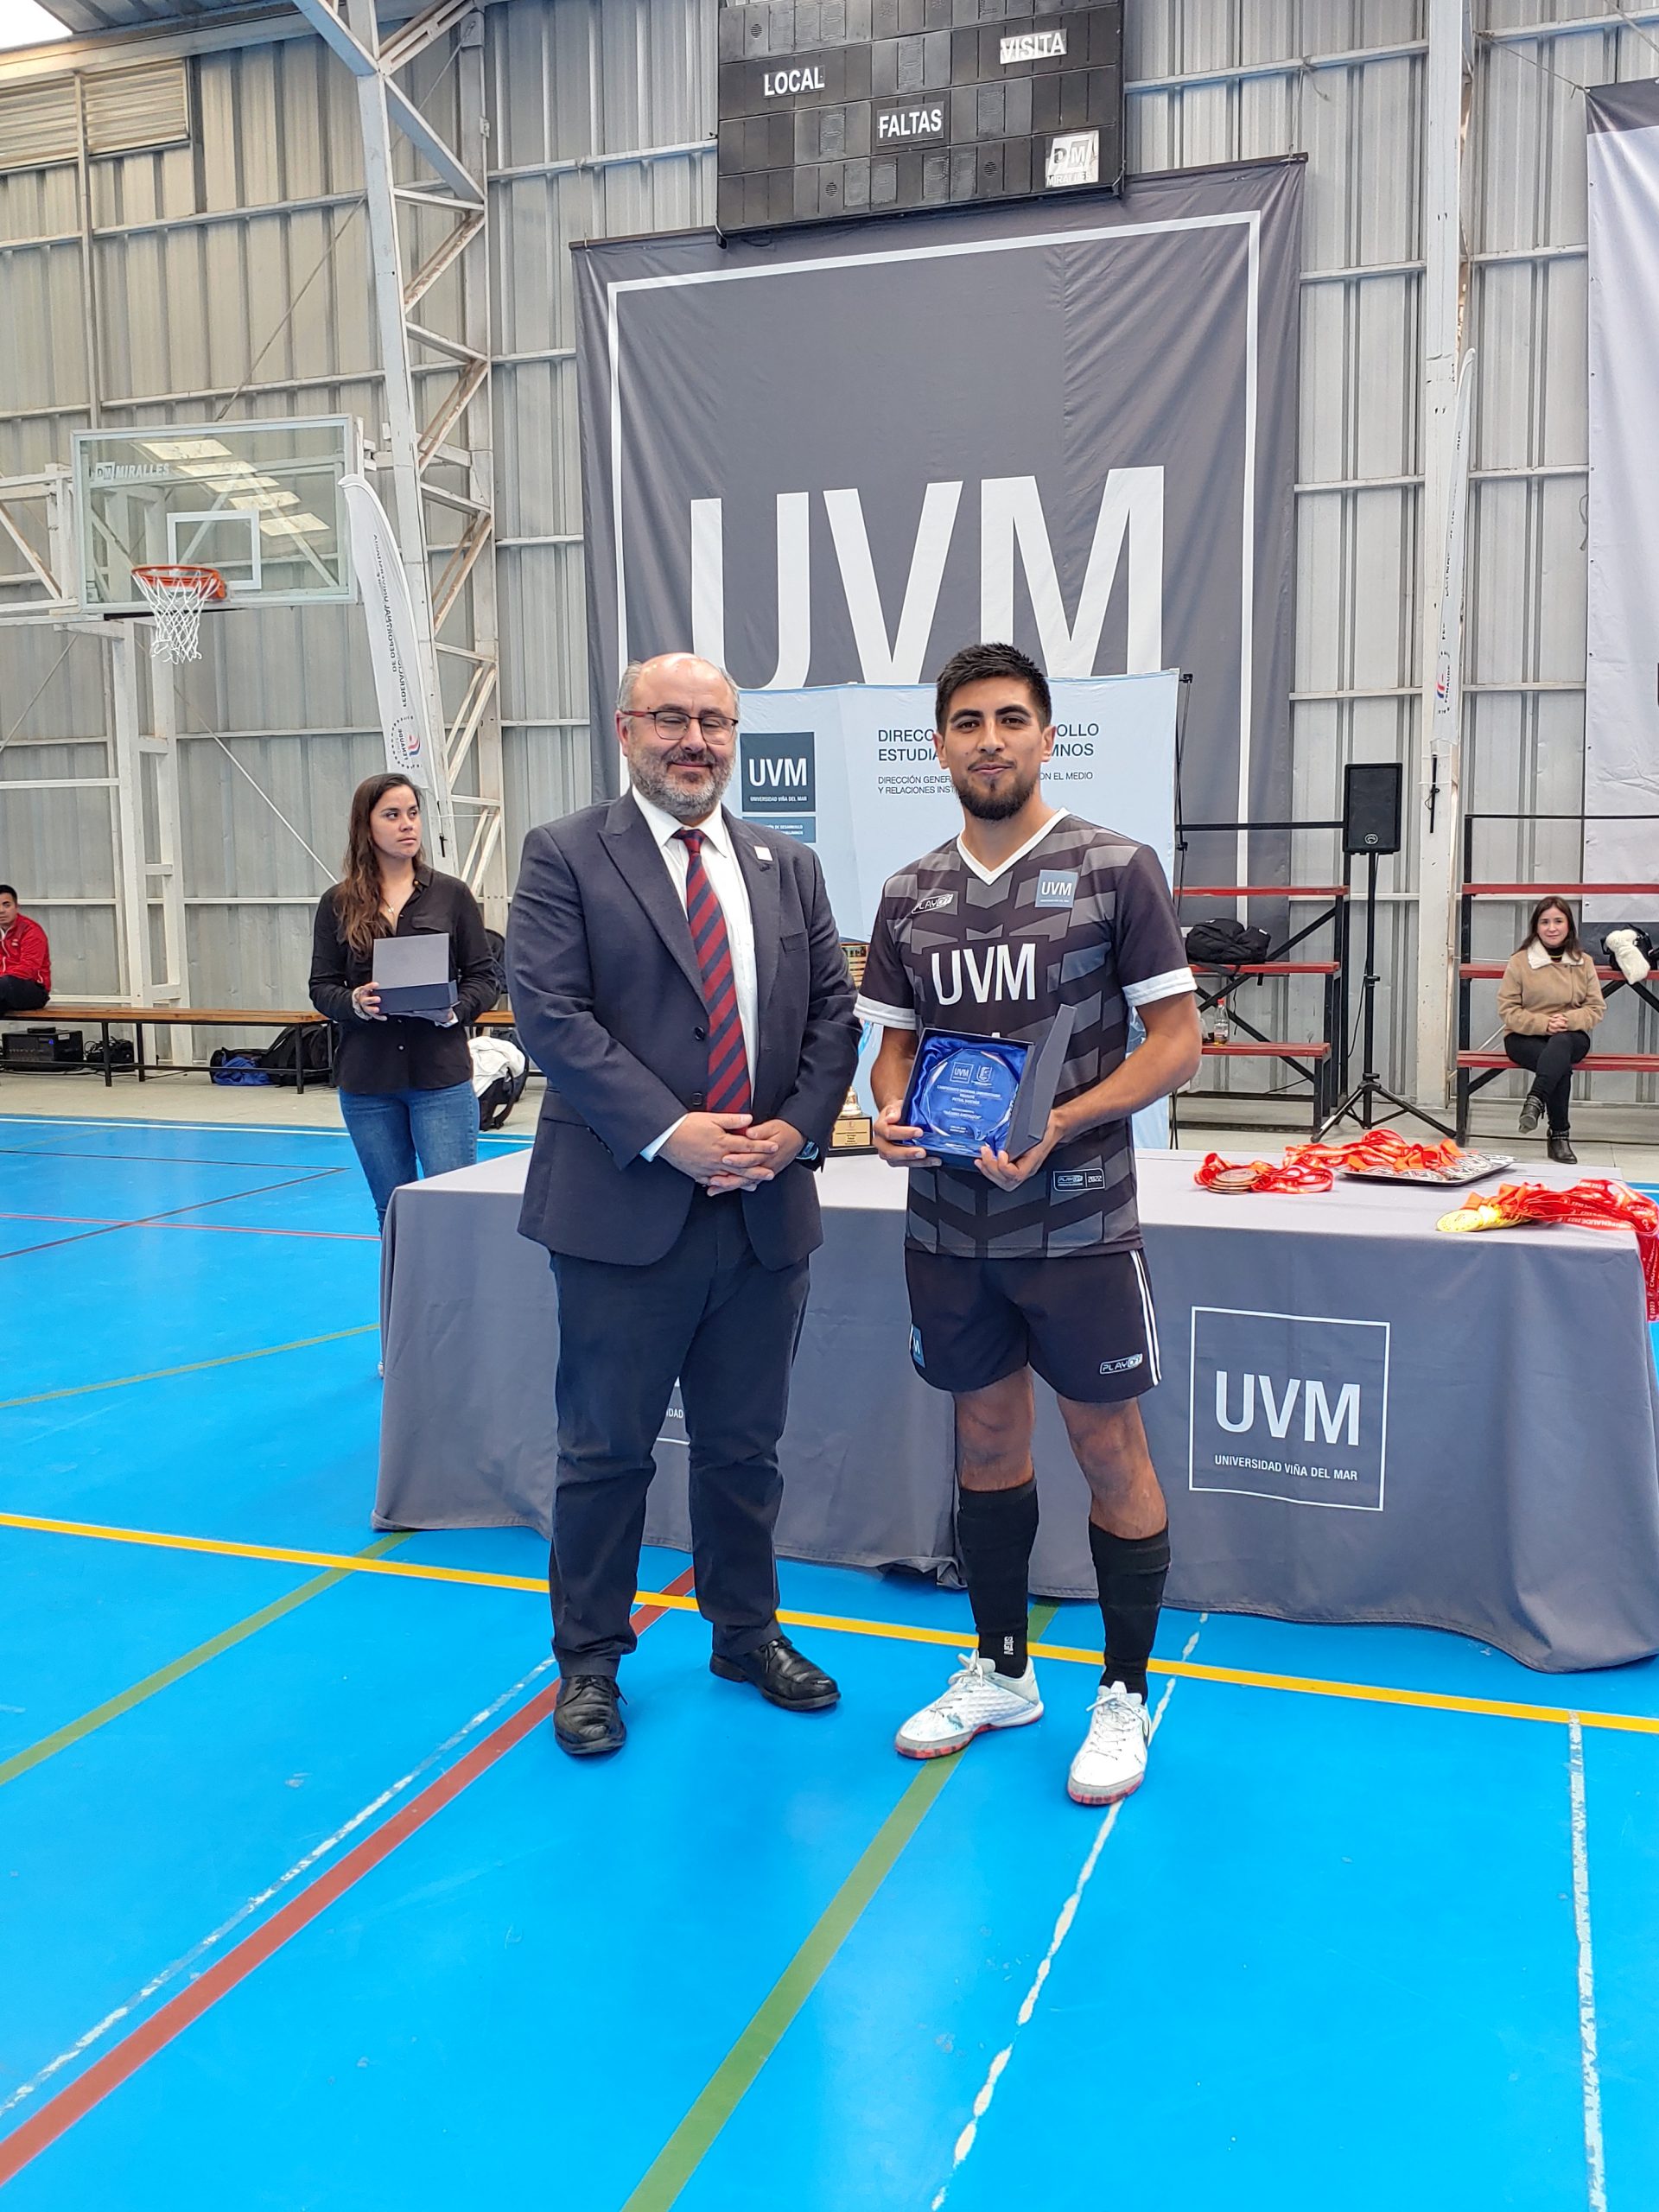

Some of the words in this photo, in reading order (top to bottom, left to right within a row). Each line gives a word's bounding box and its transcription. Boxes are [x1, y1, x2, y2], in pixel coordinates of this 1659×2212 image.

[1001, 33, 1065, 62] VISITA
[764, 67, 824, 97] LOCAL
[879, 109, 942, 138] FALTAS
[116, 463, 169, 479] MIRALLES
[691, 465, 1164, 689] UVM
[748, 758, 807, 787] UVM
[878, 775, 921, 784] DIRECCIÓN
[1053, 772, 1064, 780] EL
[1065, 772, 1093, 780] MEDIO
[1041, 881, 1072, 896] UVM
[931, 943, 1036, 1006] UVM
[954, 1067, 969, 1077] UVM
[1216, 1370, 1360, 1446] UVM
[1215, 1454, 1281, 1472] UNIVERSIDAD
[1284, 1463, 1307, 1477] VIÑA
[1311, 1467, 1330, 1478] DEL
[1333, 1470, 1357, 1481] MAR
